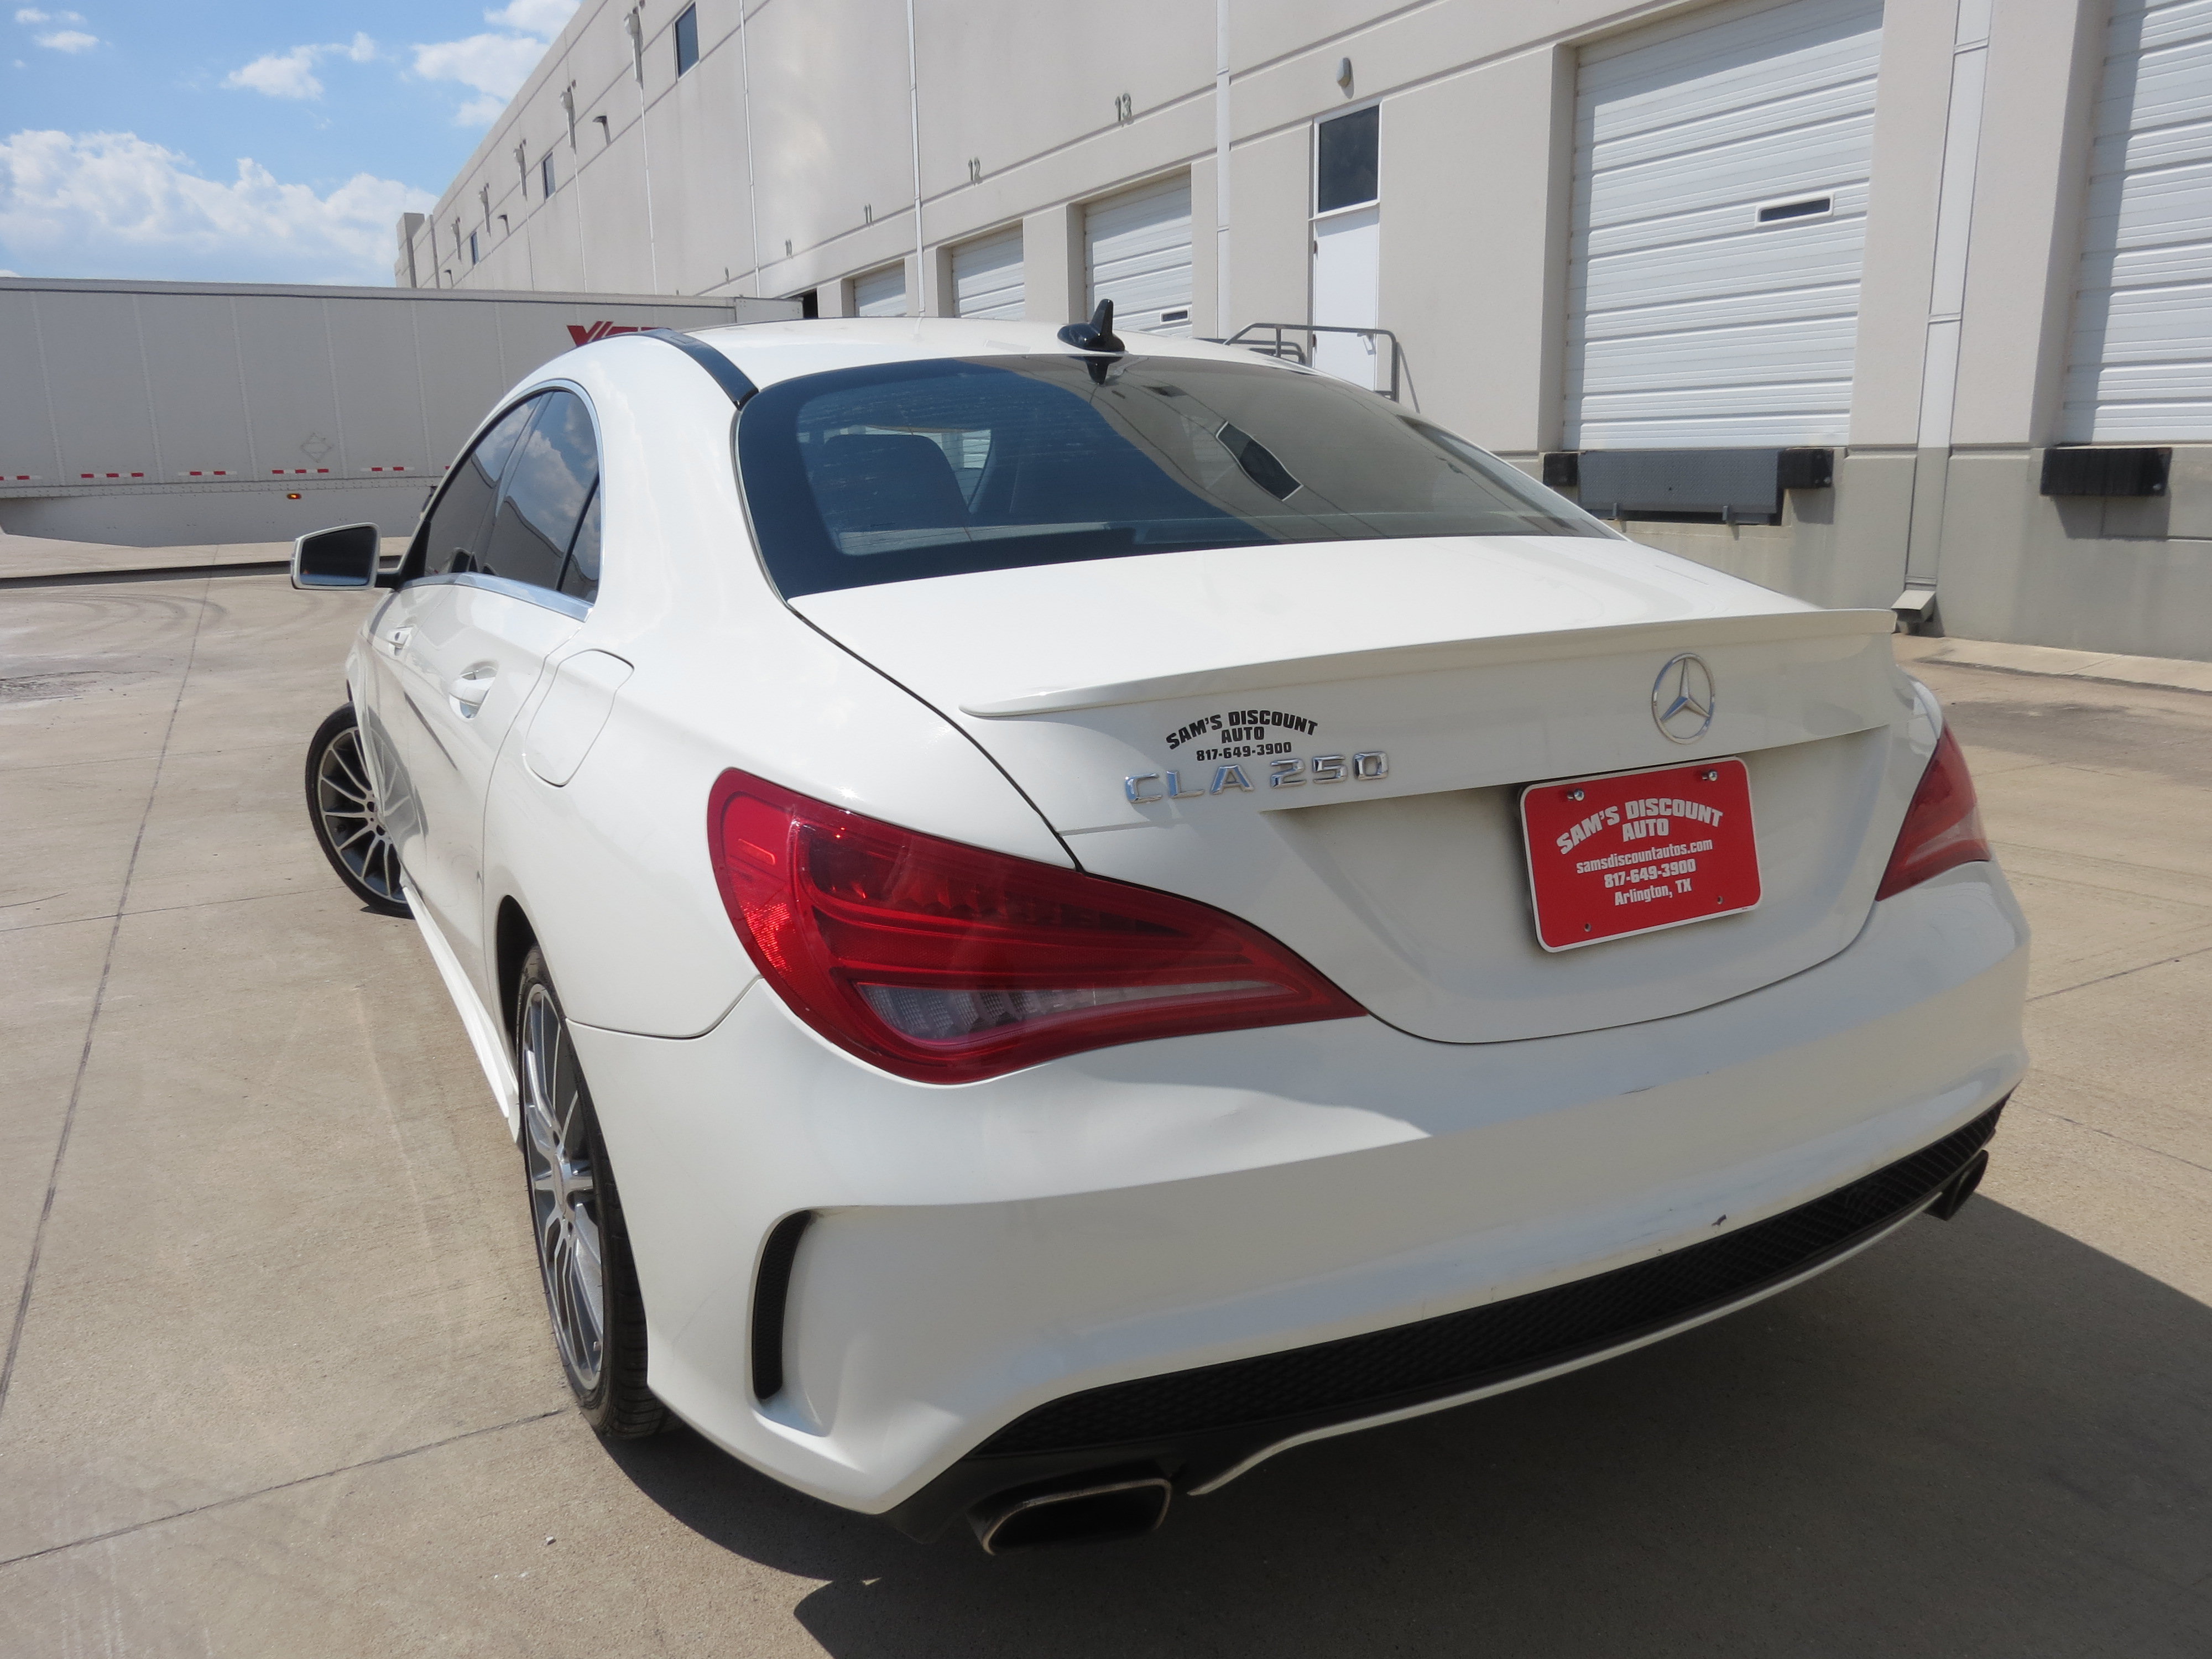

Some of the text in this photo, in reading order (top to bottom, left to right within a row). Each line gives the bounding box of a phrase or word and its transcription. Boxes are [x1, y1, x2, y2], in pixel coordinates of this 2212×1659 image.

[1115, 92, 1132, 122] 13
[1166, 709, 1318, 749] SAM'S DISCOUNT
[1221, 726, 1264, 744] AUTO
[1197, 742, 1292, 761] 817-649-3900
[1125, 751, 1389, 804] CLA 250
[1556, 798, 1723, 855] SAM'S DISCOUNT
[1622, 818, 1669, 842] AUTO
[1576, 839, 1713, 874] samsdiscountautos.com
[1604, 859, 1696, 888] 817-649-3900
[1615, 878, 1692, 906] Arlington, TX
